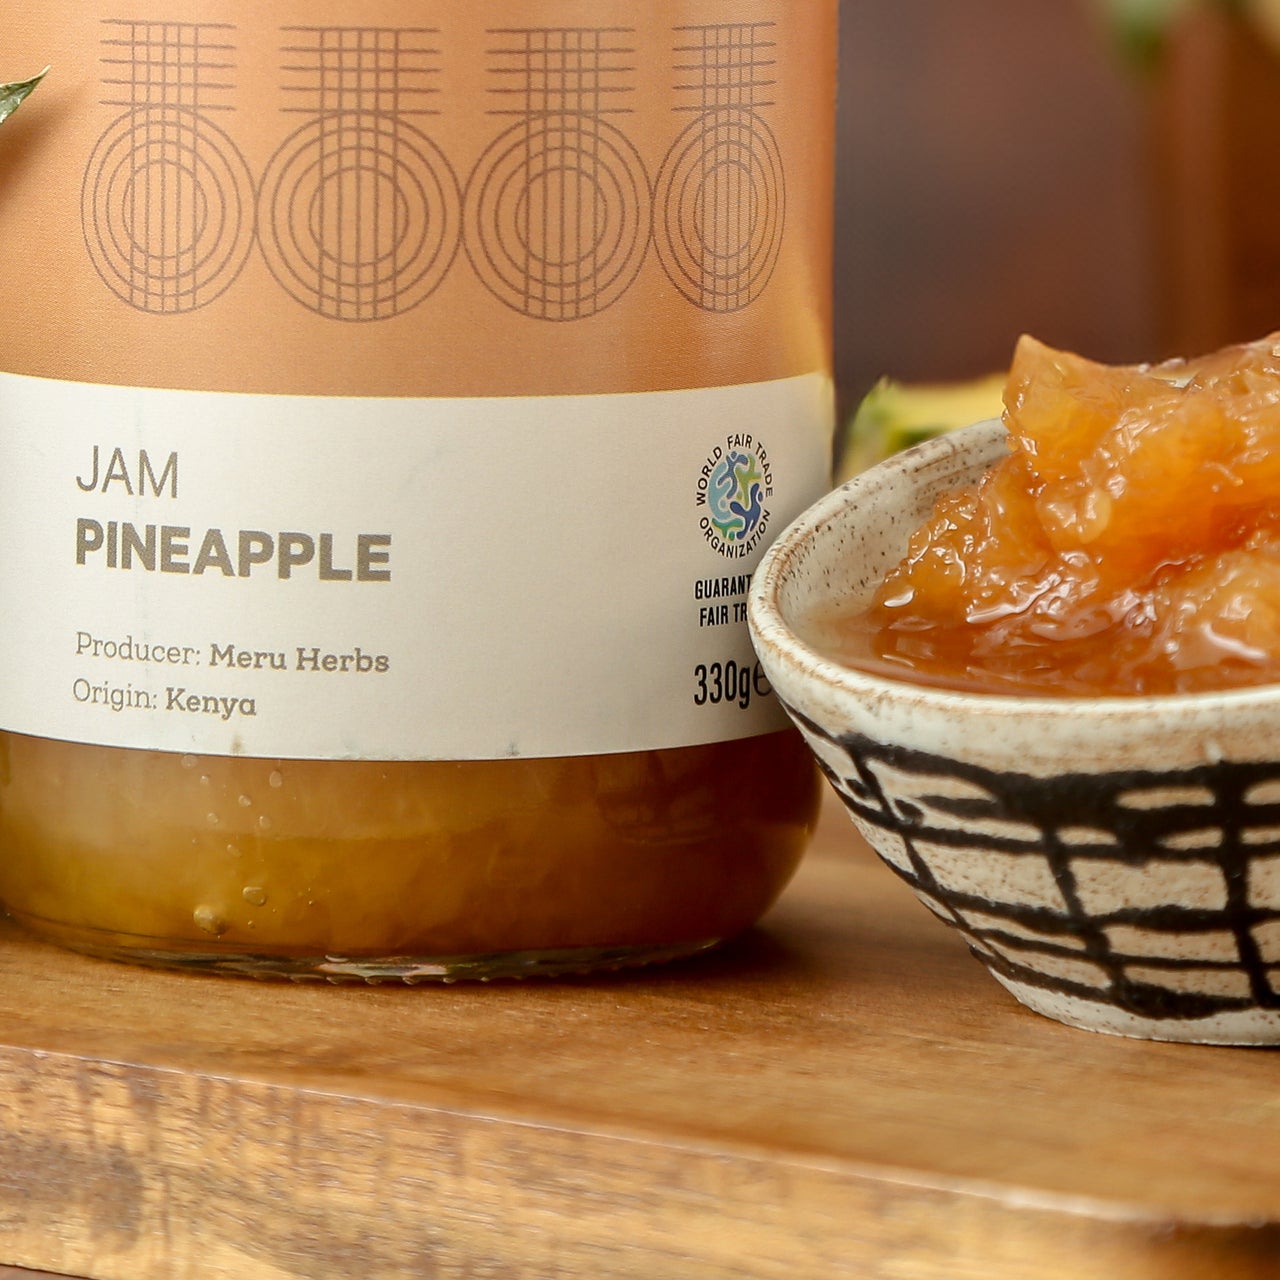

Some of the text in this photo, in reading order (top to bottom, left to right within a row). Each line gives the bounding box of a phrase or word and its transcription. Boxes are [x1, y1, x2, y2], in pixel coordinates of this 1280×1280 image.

[76, 445, 178, 499] JAM
[696, 433, 773, 506] WORLD FAIR TRADE
[76, 518, 392, 582] PINEAPPLE
[700, 509, 771, 559] ORGANIZATION
[695, 574, 753, 600] GUARANT
[700, 605, 728, 627] FAIR
[75, 631, 390, 673] Producer: Meru Herbs
[73, 678, 257, 720] Origin: Kenya
